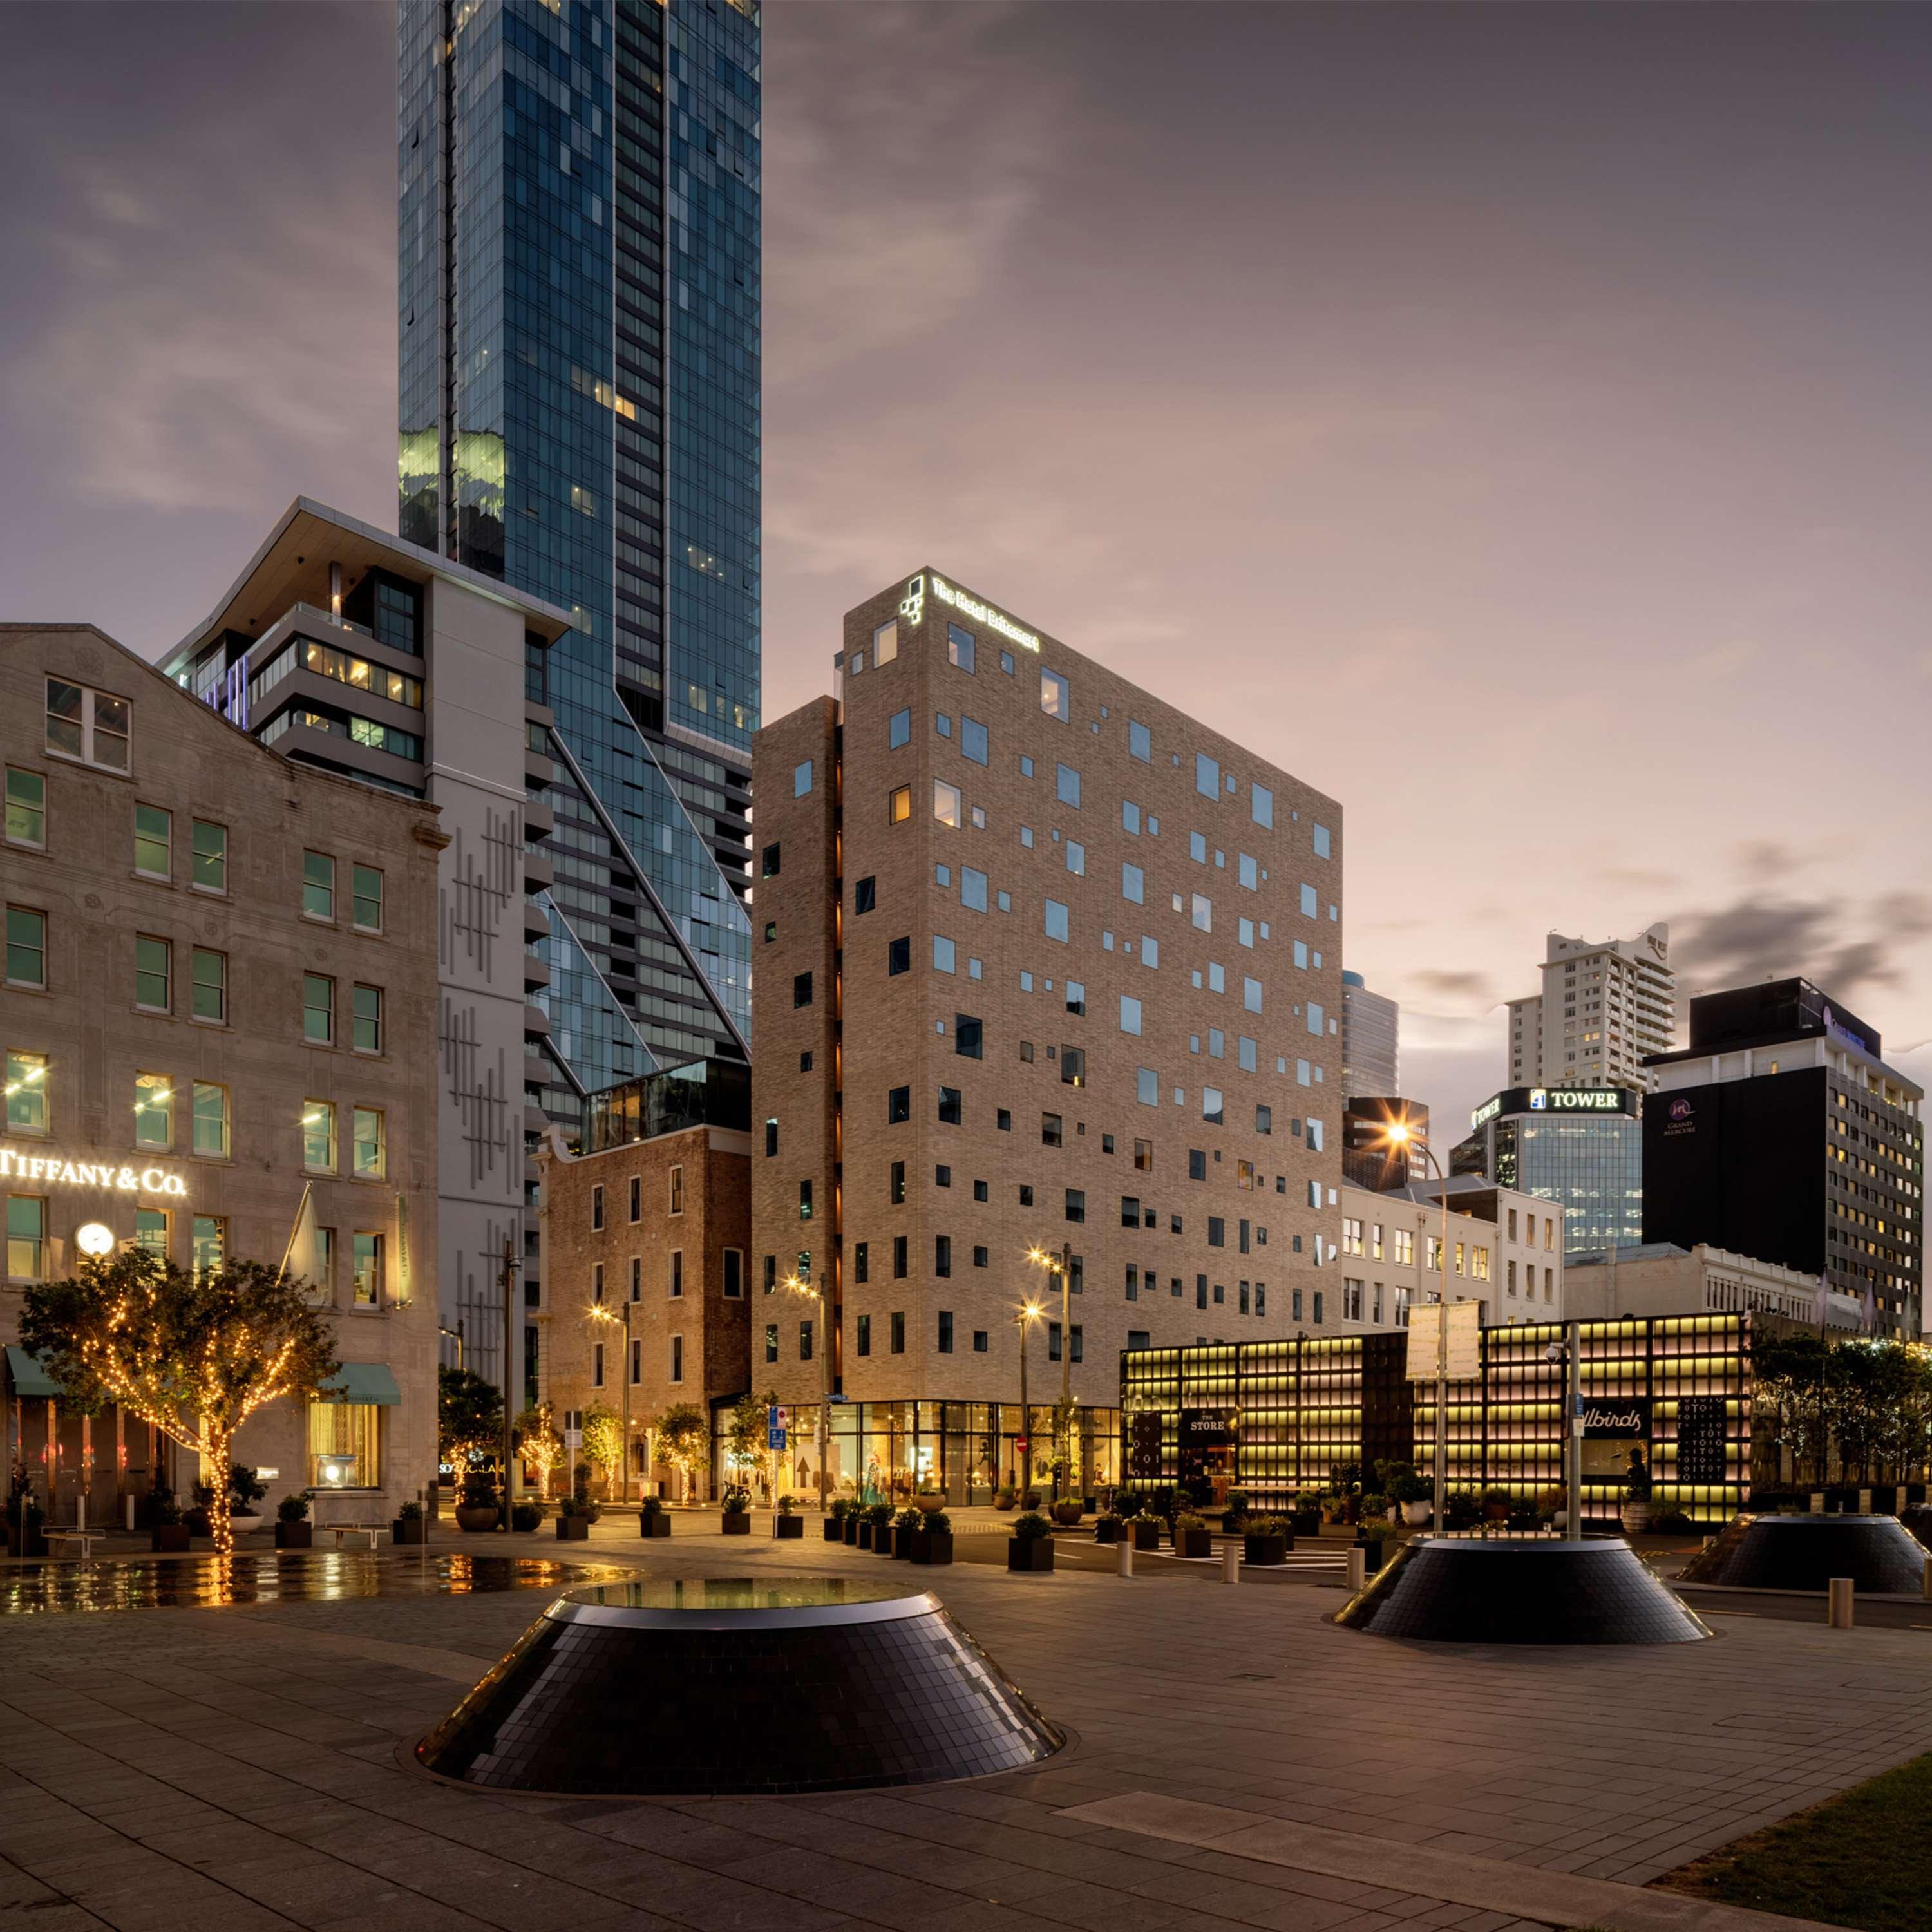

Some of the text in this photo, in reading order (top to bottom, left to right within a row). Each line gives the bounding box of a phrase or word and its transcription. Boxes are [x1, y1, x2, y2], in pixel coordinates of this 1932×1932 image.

[932, 577, 1039, 653] The Hotel Britomart
[1477, 1098, 1500, 1124] TOWER
[1551, 1092, 1618, 1108] TOWER
[0, 1150, 115, 1187] TIFFANY
[117, 1167, 139, 1190] &
[1190, 1421, 1225, 1431] STORE
[1584, 1408, 1642, 1432] llbirds
